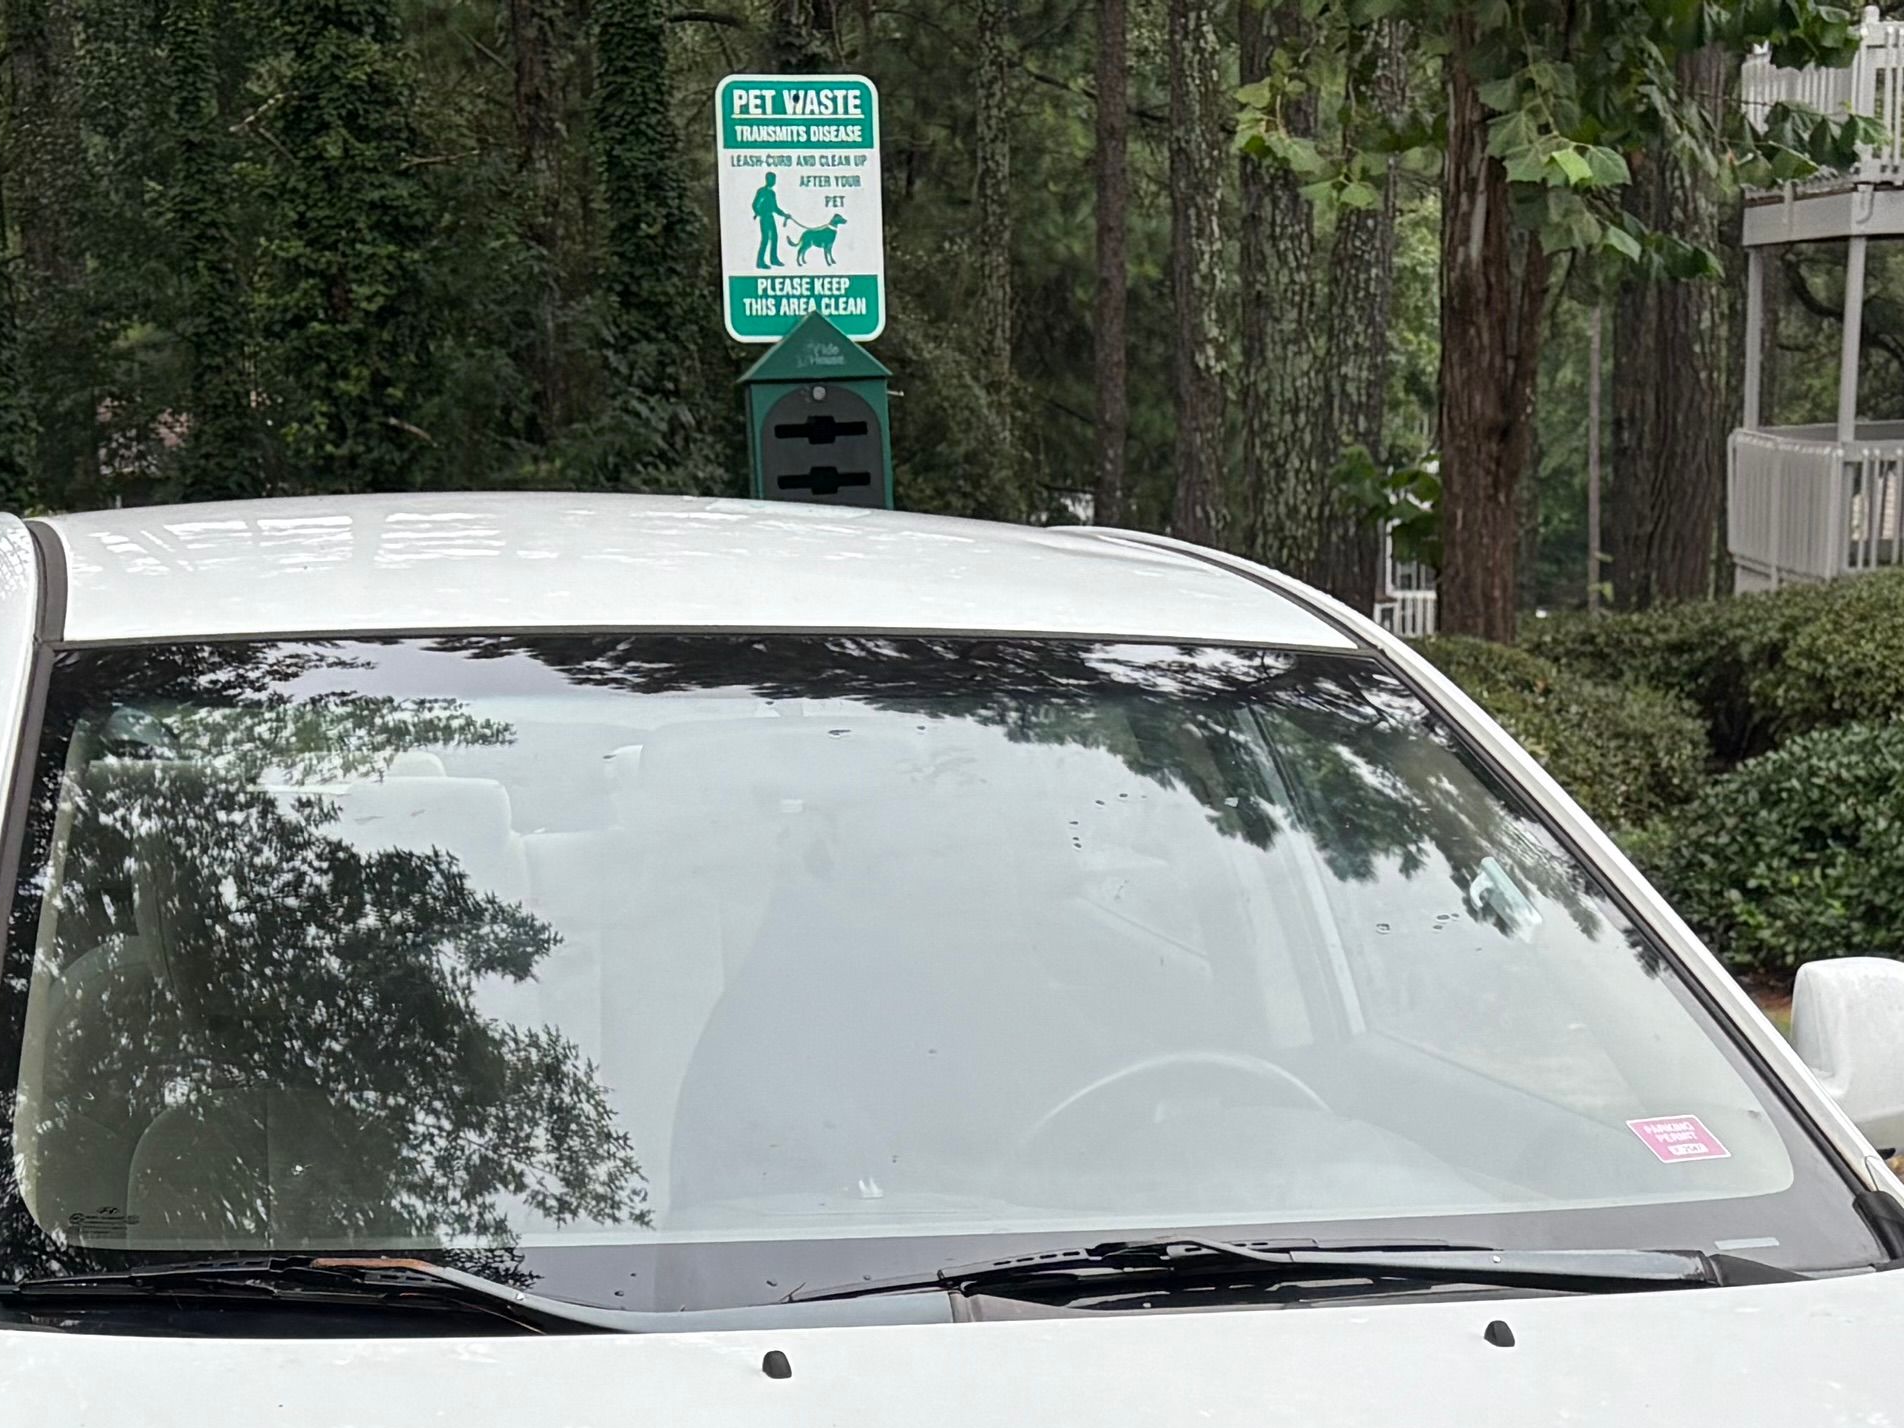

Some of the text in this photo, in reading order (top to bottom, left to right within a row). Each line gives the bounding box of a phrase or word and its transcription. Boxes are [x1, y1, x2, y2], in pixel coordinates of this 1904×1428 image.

[732, 89, 862, 115] PET WASTE
[735, 125, 862, 142] TRANSMITS DISEASE
[796, 155, 816, 167] AND
[819, 154, 851, 167] CLEAN
[853, 154, 867, 167] UP
[799, 175, 861, 188] AFTER YOUR
[825, 195, 845, 208] PET
[757, 277, 849, 296] PLEASE KEEP
[743, 297, 866, 316] THIS AREA CLEAN
